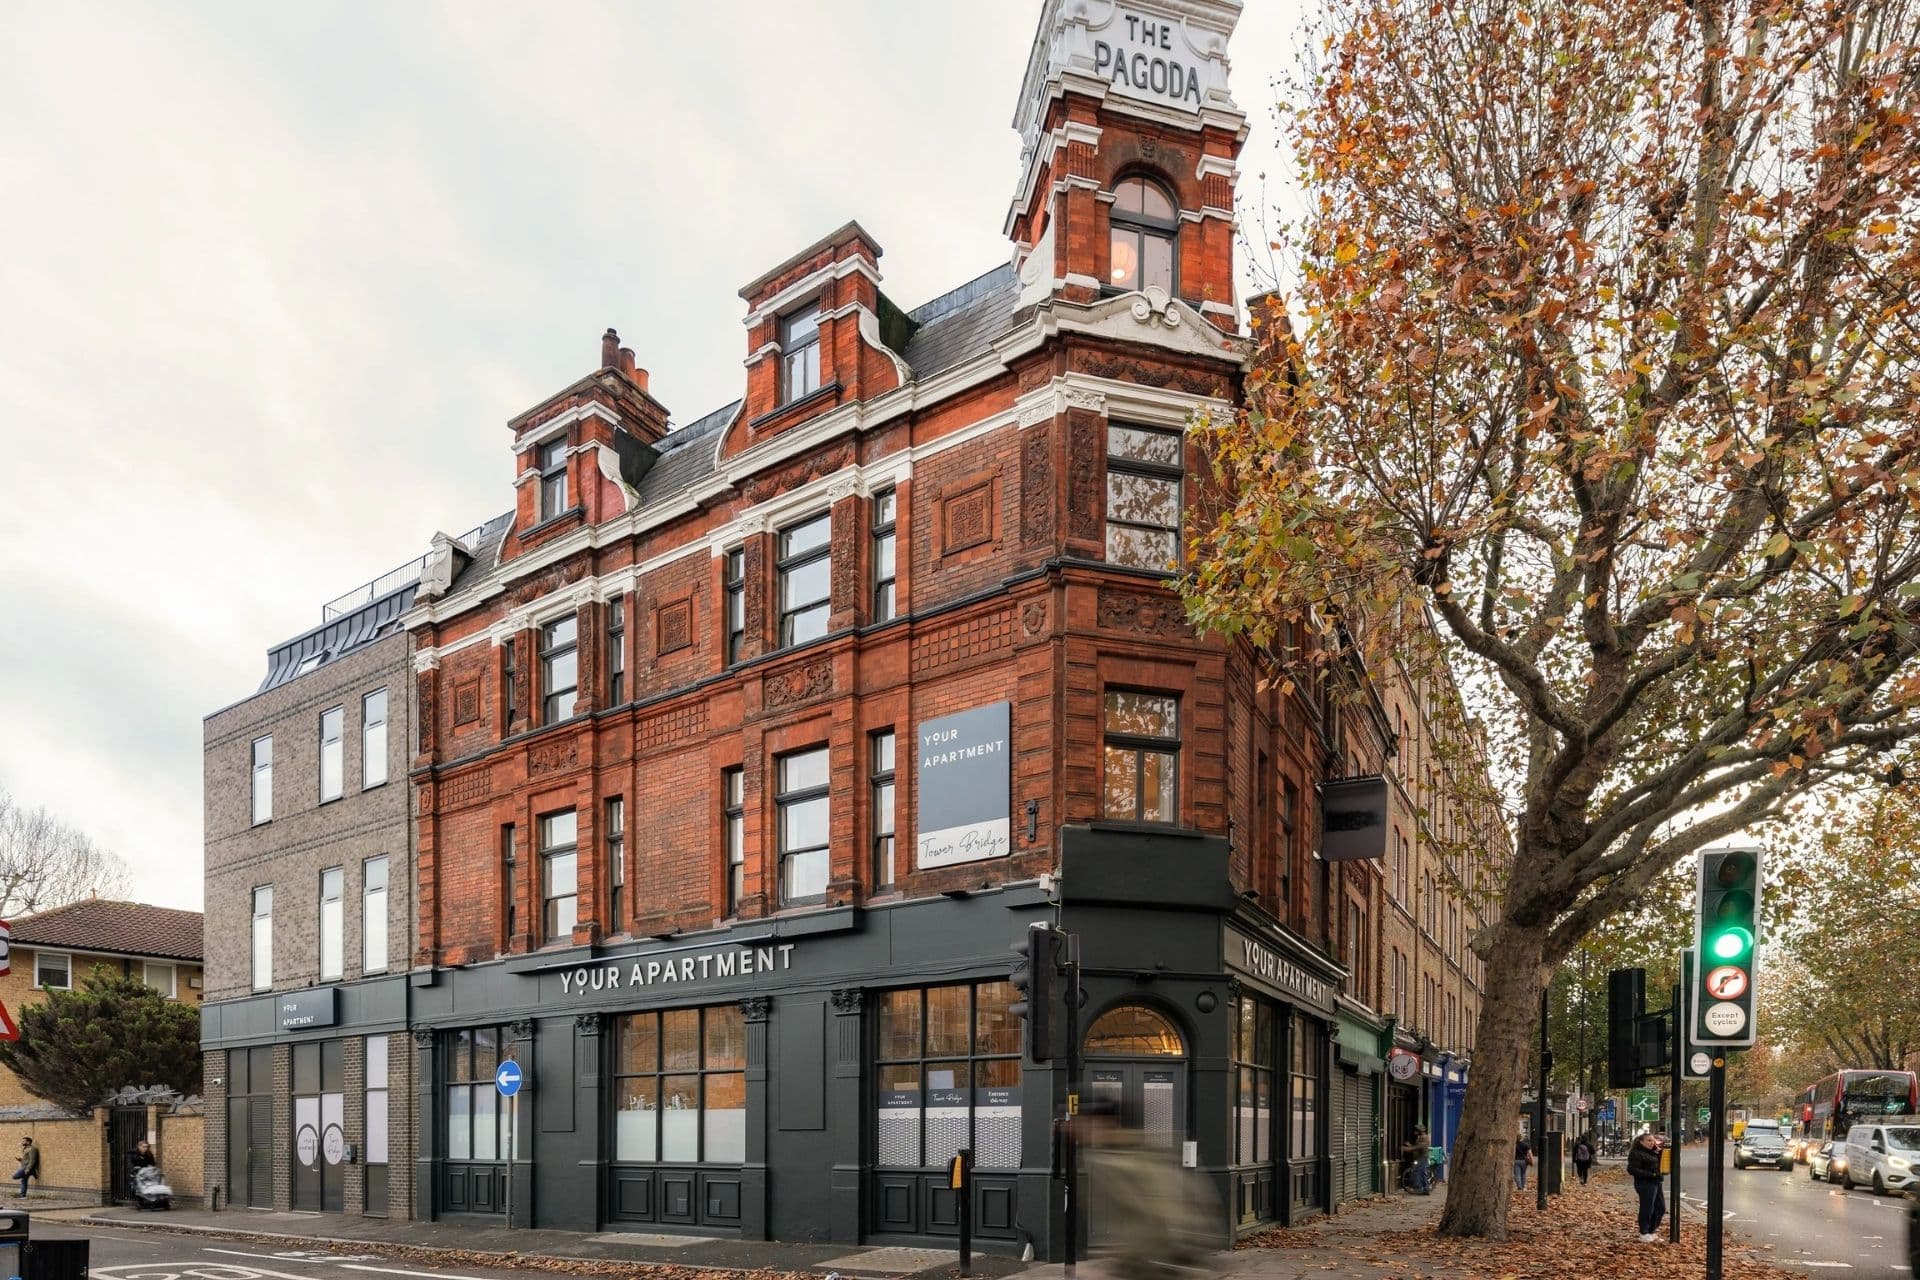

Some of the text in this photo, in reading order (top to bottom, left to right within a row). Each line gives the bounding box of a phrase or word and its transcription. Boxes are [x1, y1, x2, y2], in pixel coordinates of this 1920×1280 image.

[1125, 14, 1172, 51] THE
[1094, 39, 1202, 105] PAGODA
[923, 729, 959, 746] YOUR
[923, 740, 1005, 769] APARTMENT
[920, 830, 1008, 859] Tower Bridge
[559, 943, 795, 995] YOUR APARTMENT
[1244, 939, 1327, 1005] YOUR APARTMENT
[283, 1015, 314, 1026] APARTMENT
[1711, 1012, 1738, 1020] Except
